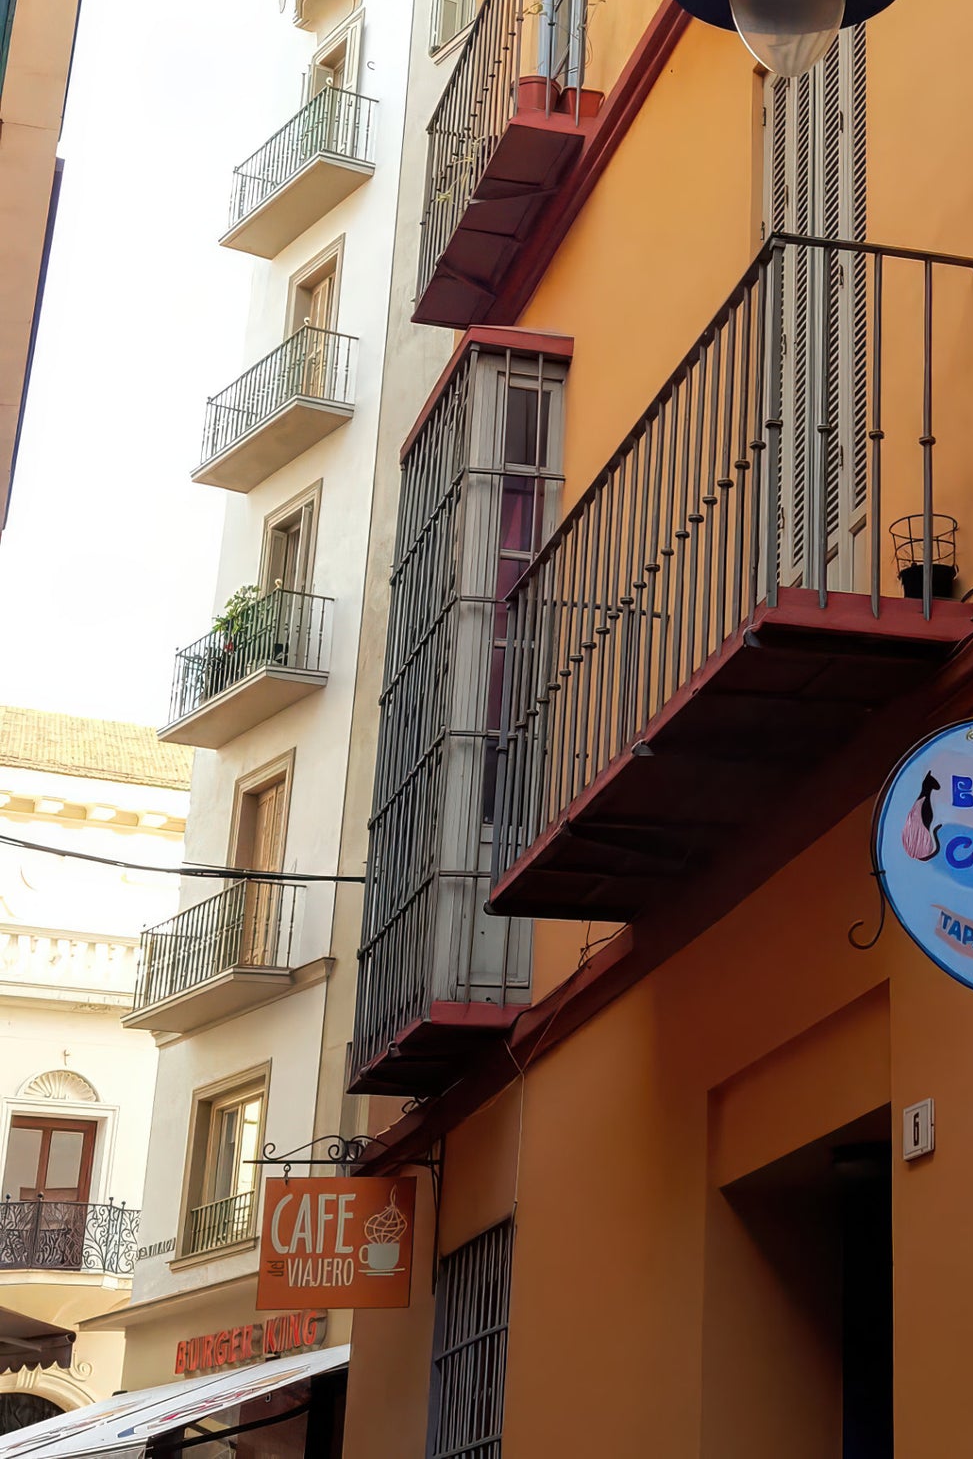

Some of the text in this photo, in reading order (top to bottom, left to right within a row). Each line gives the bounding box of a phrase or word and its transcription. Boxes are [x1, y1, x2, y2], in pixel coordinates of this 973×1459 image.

[913, 1112, 920, 1147] 6
[270, 1193, 357, 1255] CAFE
[287, 1257, 355, 1287] VIAJERO
[174, 1310, 319, 1375] BURGER KING
